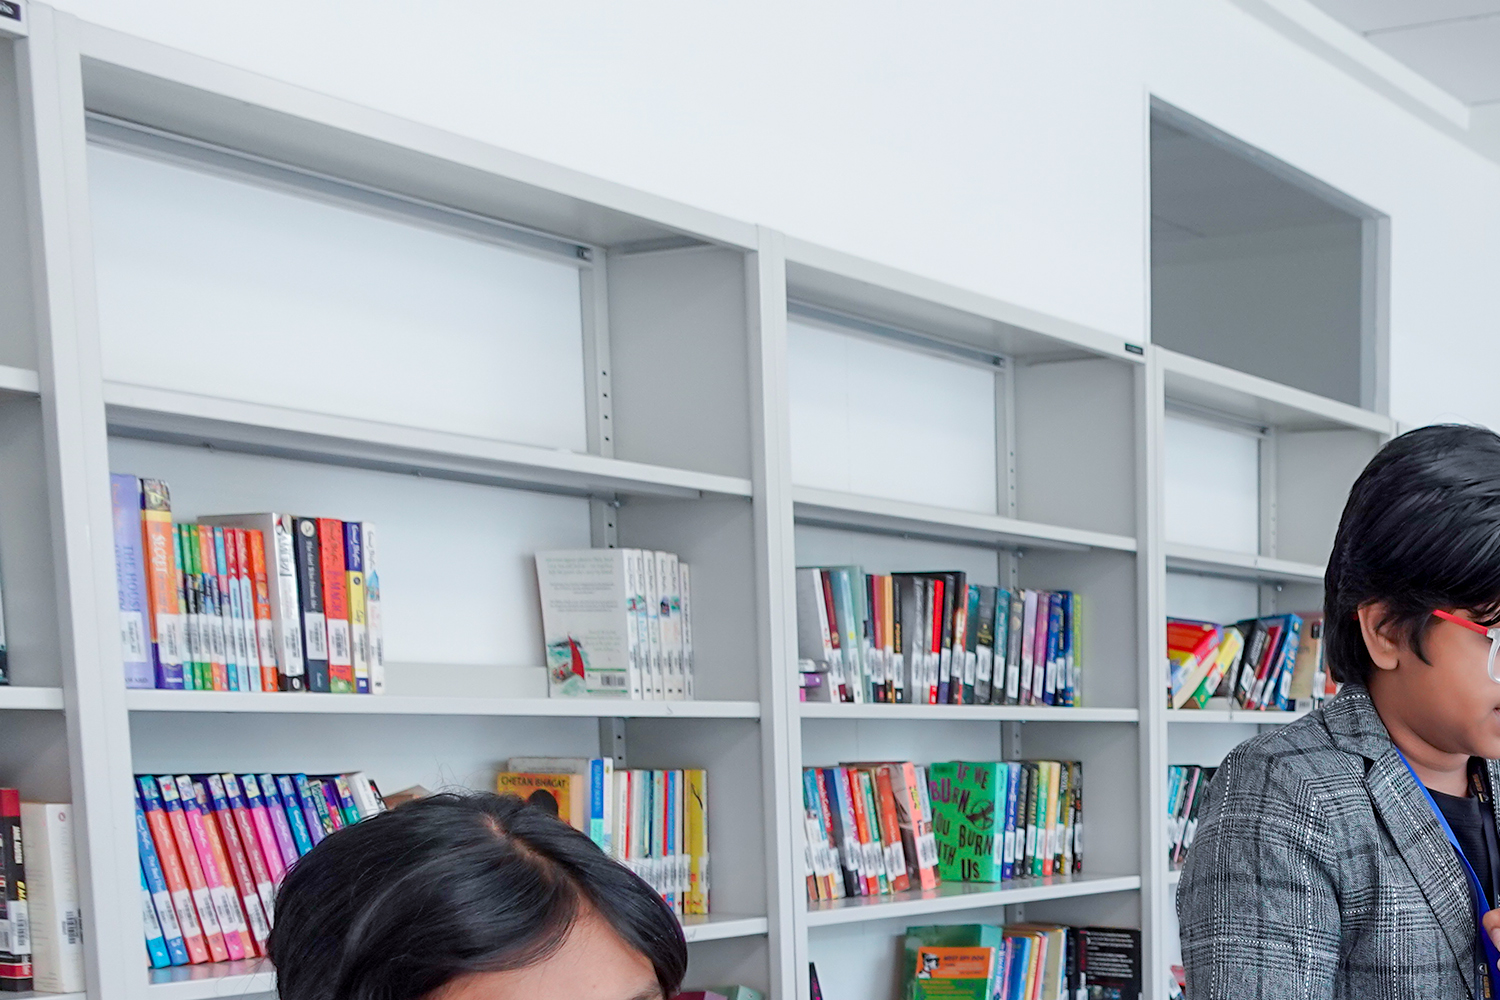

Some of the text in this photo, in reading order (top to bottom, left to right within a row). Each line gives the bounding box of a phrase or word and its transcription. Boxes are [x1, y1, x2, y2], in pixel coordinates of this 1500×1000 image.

[126, 572, 140, 612] HOUS
[929, 778, 970, 813] BURN
[959, 825, 994, 856] BURN
[961, 859, 980, 879] US
